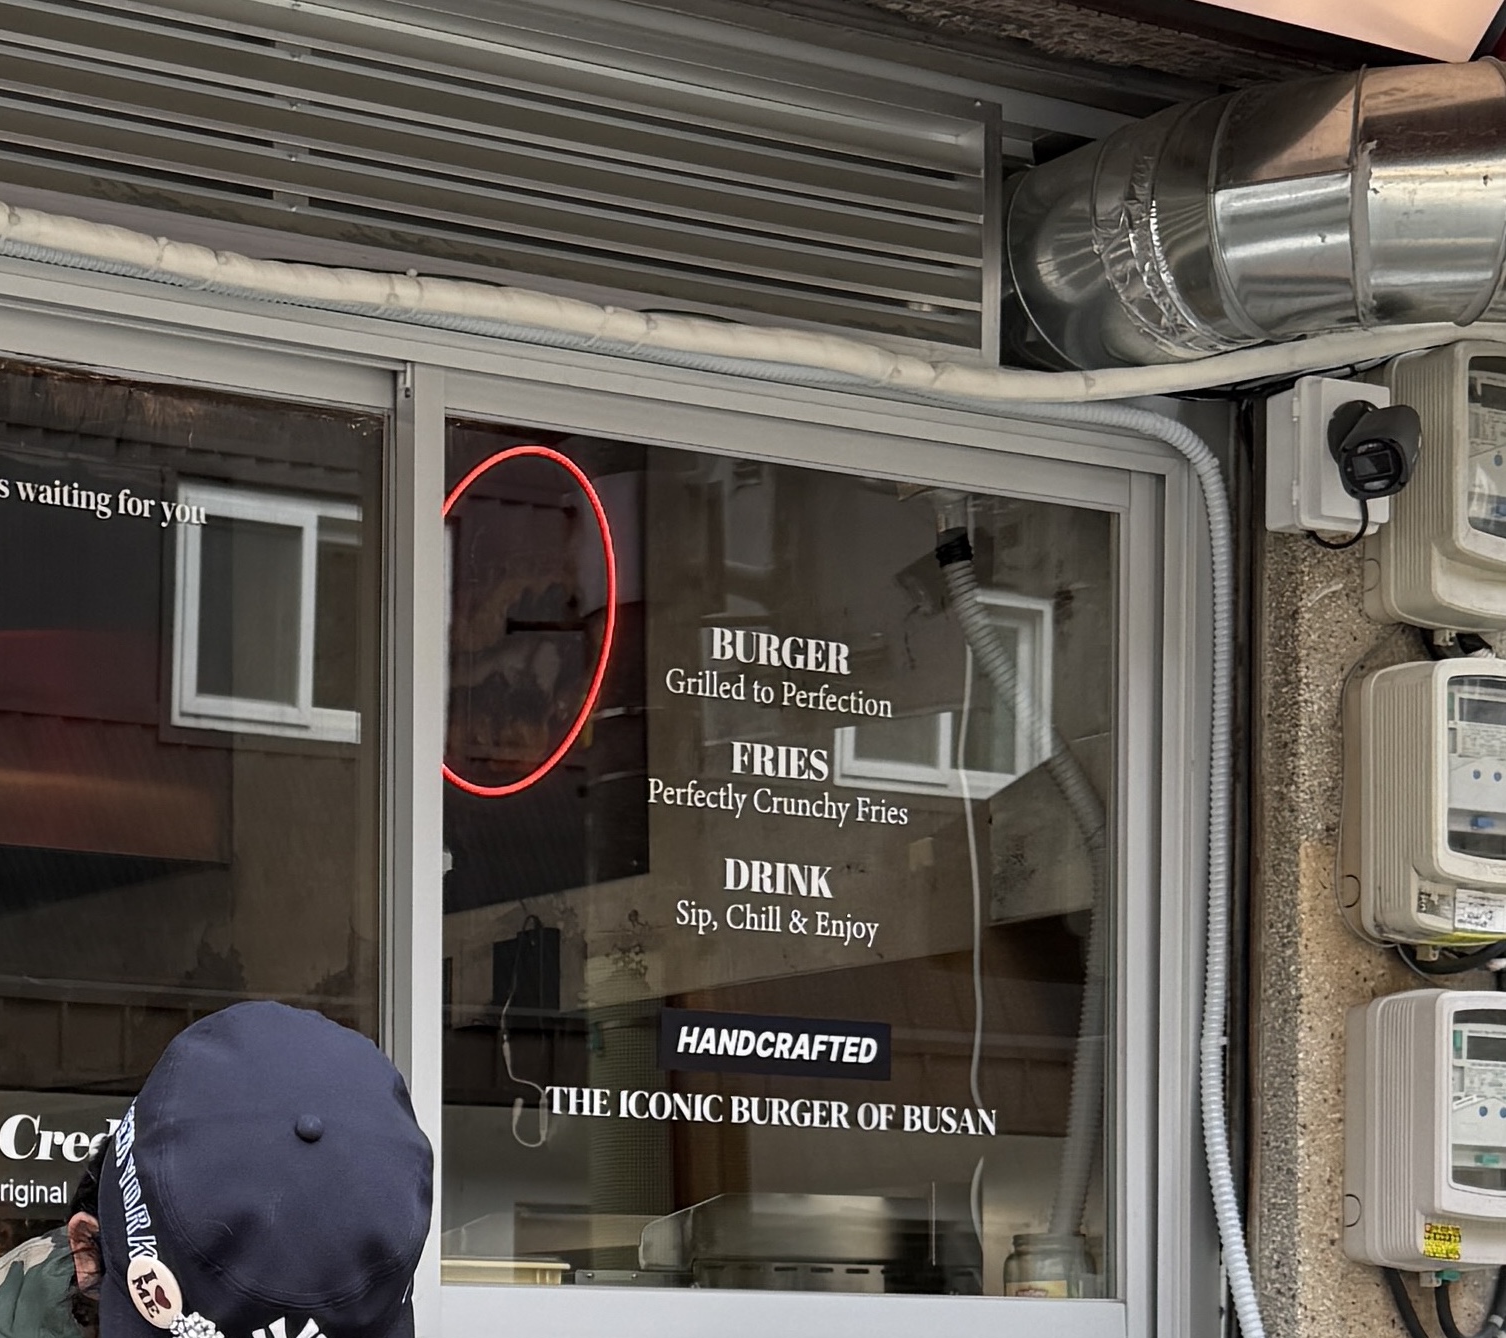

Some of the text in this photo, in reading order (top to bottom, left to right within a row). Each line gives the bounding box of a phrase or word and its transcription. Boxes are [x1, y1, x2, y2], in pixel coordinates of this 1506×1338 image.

[15, 475, 112, 521] waiting
[118, 488, 155, 520] for
[711, 627, 850, 675] BURGER
[666, 669, 893, 719] Grilled to Perfection
[730, 741, 828, 781] FRIES
[648, 778, 908, 829] Perfectly Crunchy Fries
[723, 858, 833, 899] DRINK
[676, 900, 879, 946] Sip, Chill & Enjoy
[677, 1025, 878, 1065] HANDCRAFTED
[546, 1086, 996, 1138] THE ICONIC BURGER OF BUSAN
[131, 1275, 160, 1319] ME
